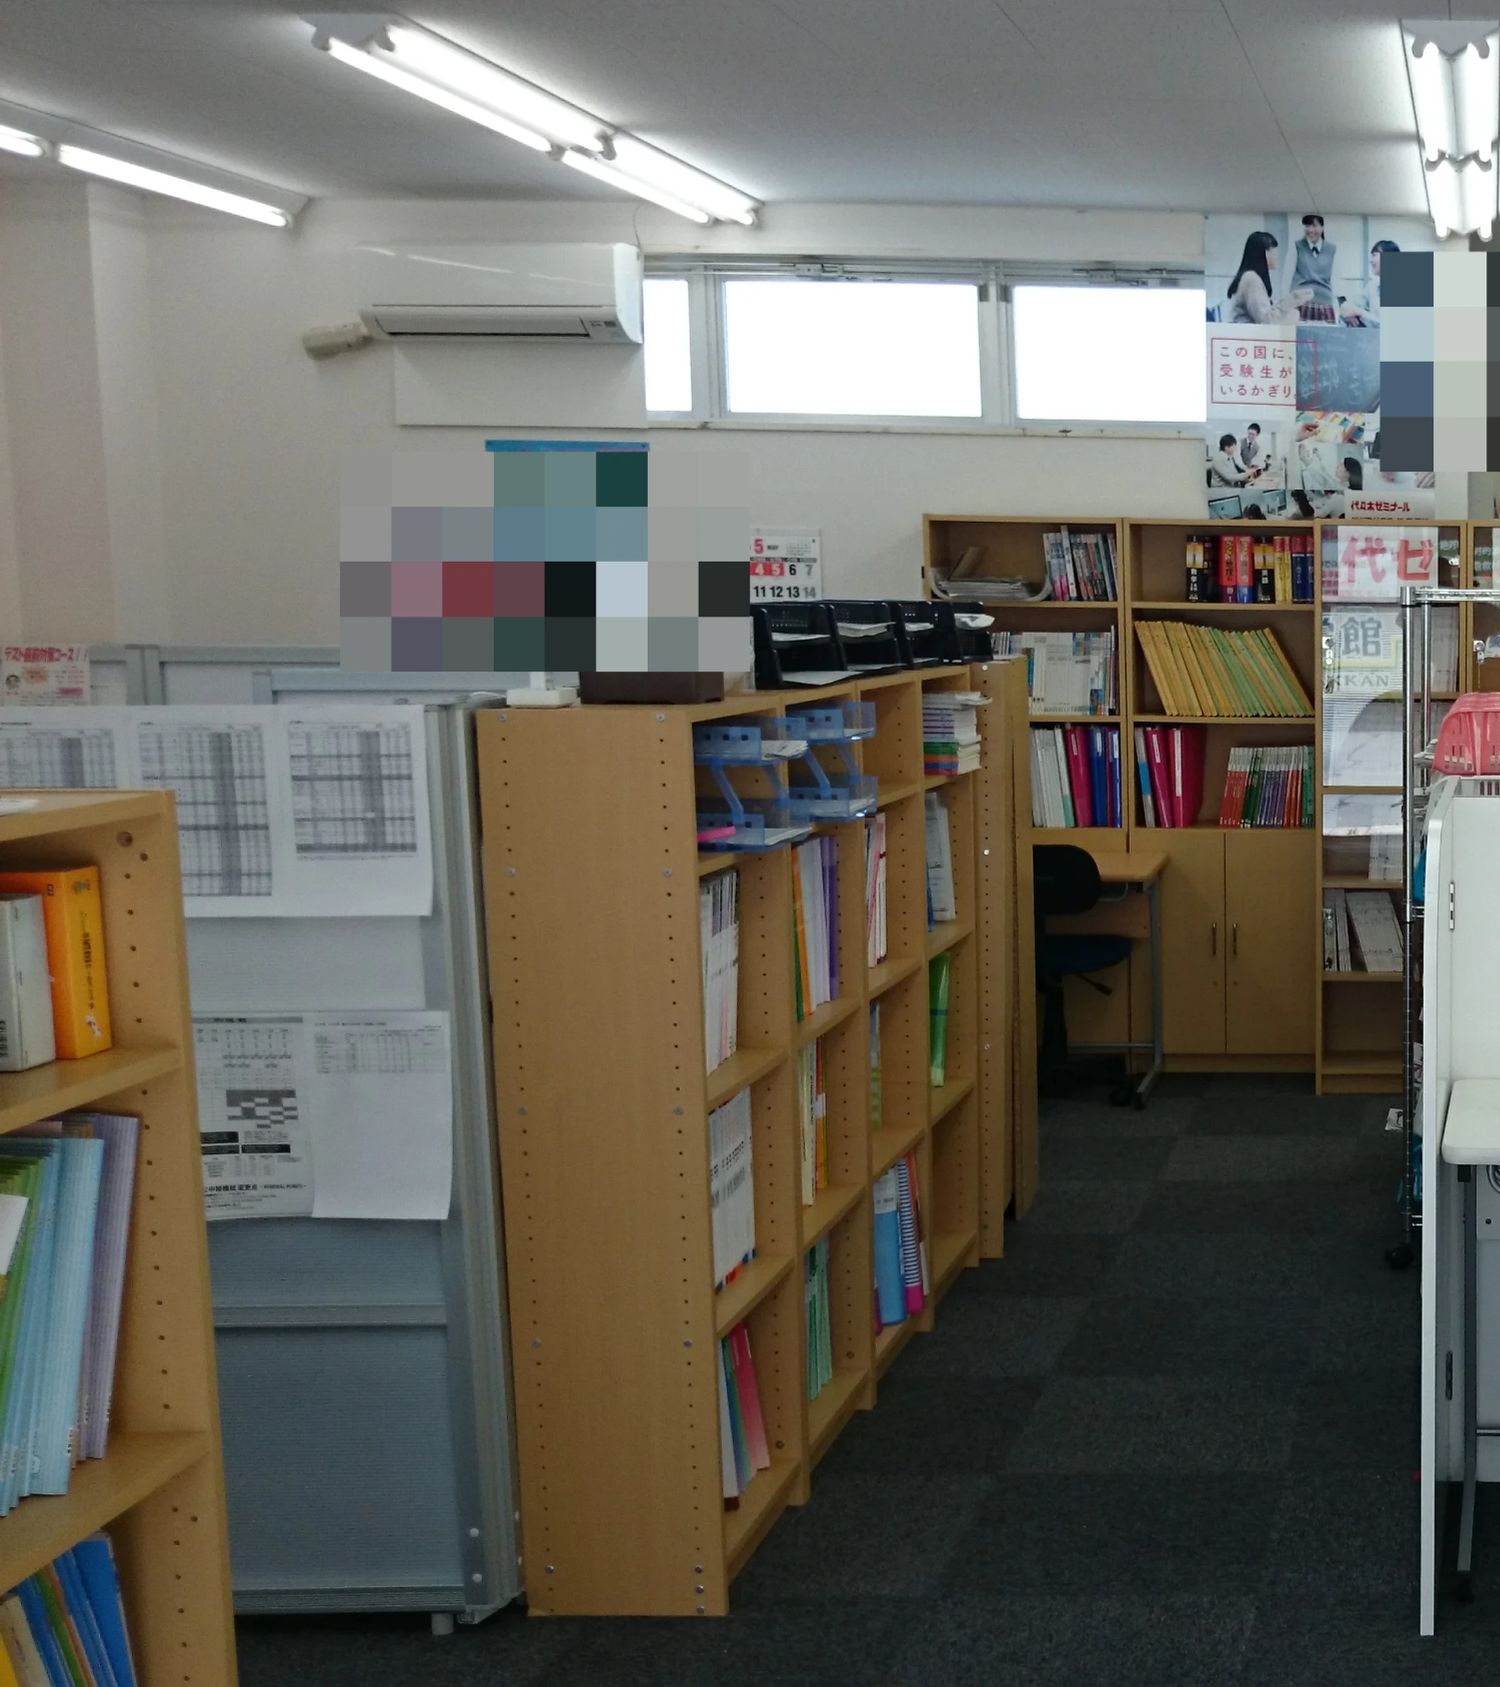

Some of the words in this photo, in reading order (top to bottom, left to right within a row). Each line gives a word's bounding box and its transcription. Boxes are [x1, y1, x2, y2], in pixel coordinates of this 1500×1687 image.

[1220, 346, 1293, 360] この国に、
[1219, 364, 1292, 378] 受験生が
[754, 538, 764, 554] 5
[755, 563, 764, 576] 4
[771, 563, 780, 576] 5
[789, 564, 797, 576] 6
[805, 564, 813, 576] 7
[753, 585, 766, 598] 11
[769, 585, 783, 598] 12
[786, 586, 800, 598] 13
[803, 586, 816, 598] 14
[1340, 617, 1382, 657] 館
